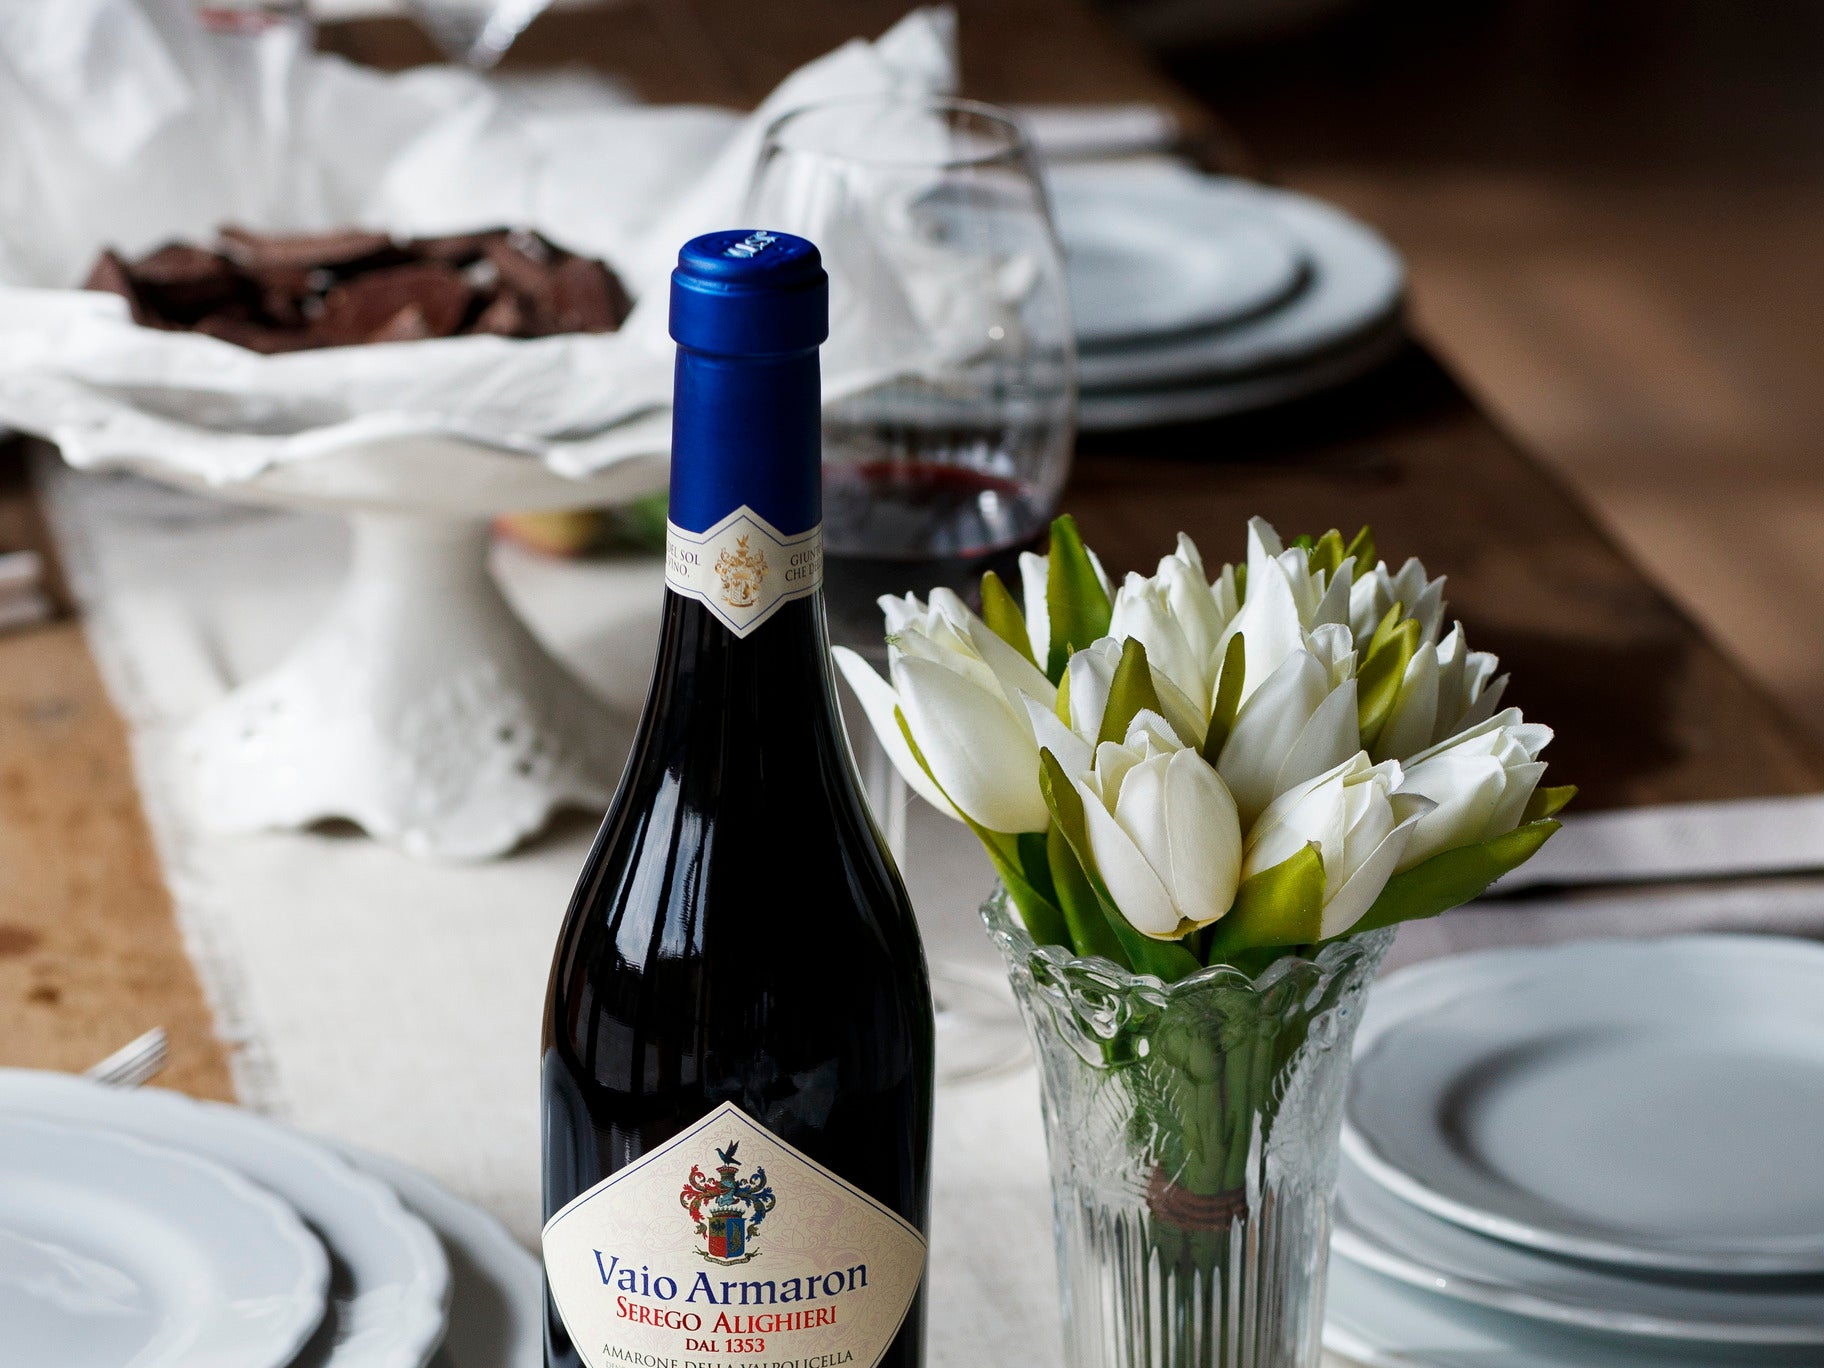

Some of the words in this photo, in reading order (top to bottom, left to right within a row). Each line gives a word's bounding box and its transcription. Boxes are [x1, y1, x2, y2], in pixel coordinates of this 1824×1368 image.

[680, 549, 701, 567] SOL
[784, 564, 807, 582] CHE
[592, 1249, 678, 1301] Vaio
[685, 1263, 869, 1306] Armaron
[615, 1295, 702, 1332] SEREGO
[712, 1304, 837, 1334] ALIGHIERI
[685, 1339, 719, 1353] DAL
[724, 1338, 765, 1353] 1353
